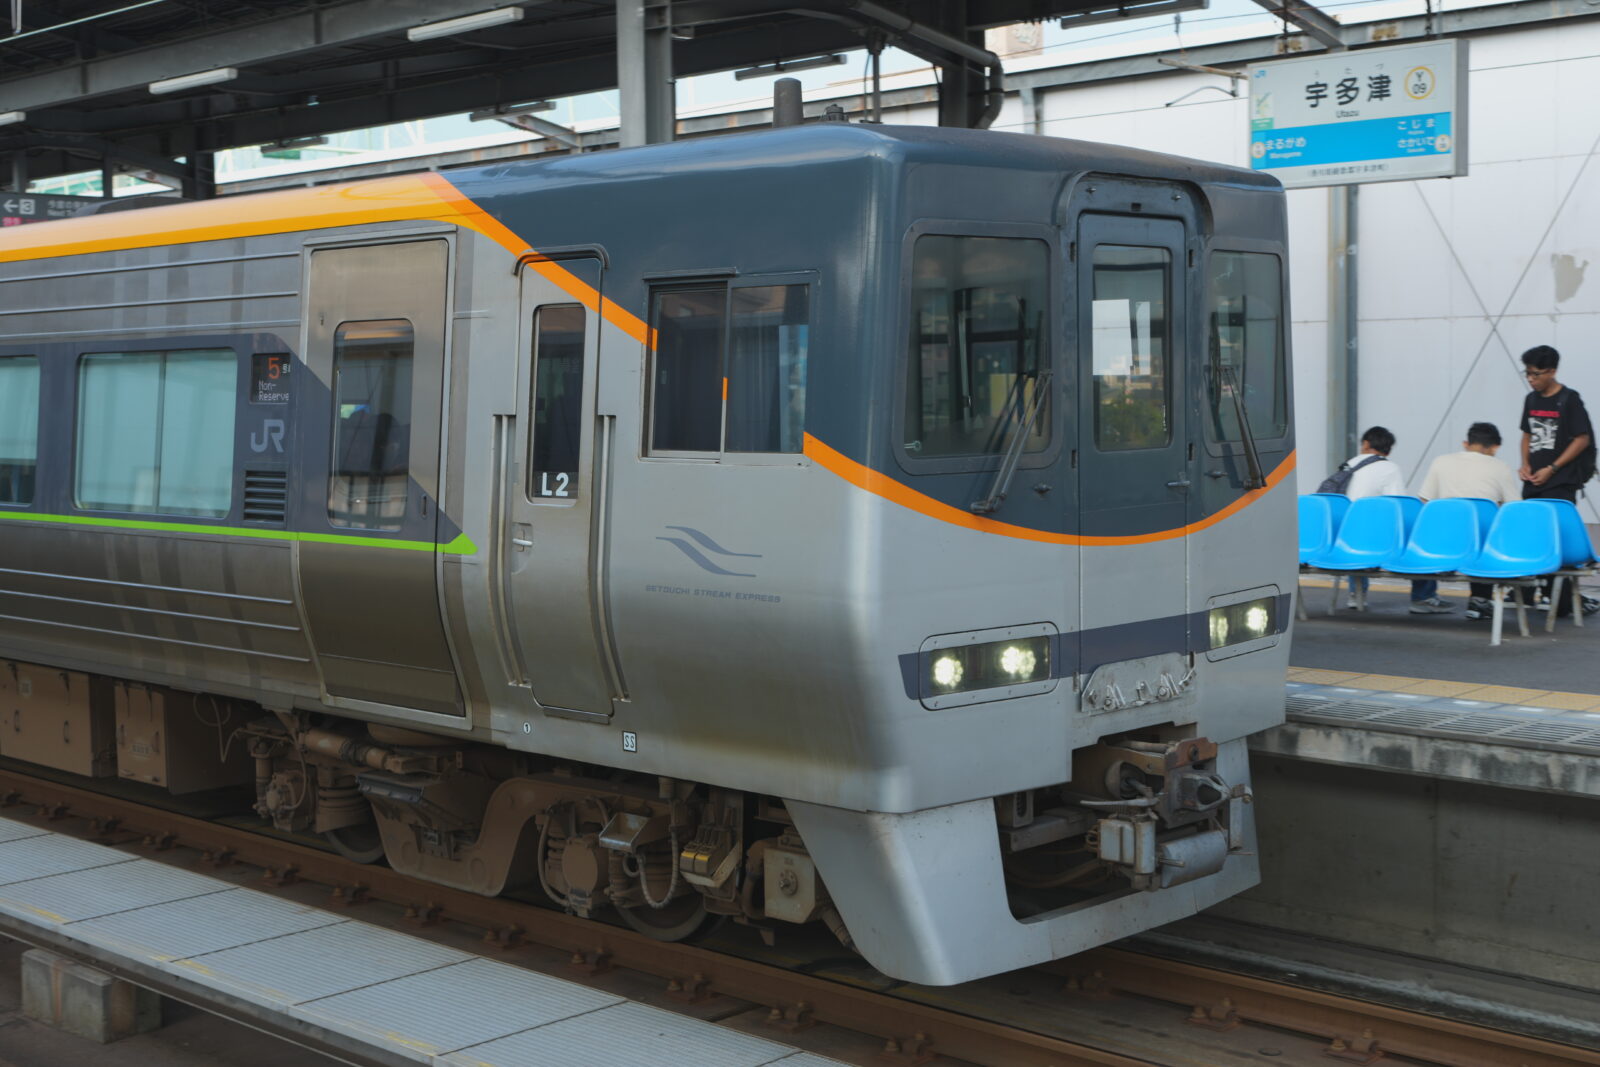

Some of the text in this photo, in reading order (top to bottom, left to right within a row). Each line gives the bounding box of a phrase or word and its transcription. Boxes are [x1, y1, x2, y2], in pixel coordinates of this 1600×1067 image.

[1416, 71, 1424, 82] Y
[1305, 74, 1392, 108] 宇多津
[1412, 83, 1427, 94] 09
[250, 419, 285, 453] JR
[541, 472, 569, 497] L2
[645, 584, 781, 604] SETOUCHI STREAM EXPRESS
[624, 734, 636, 749] SS
